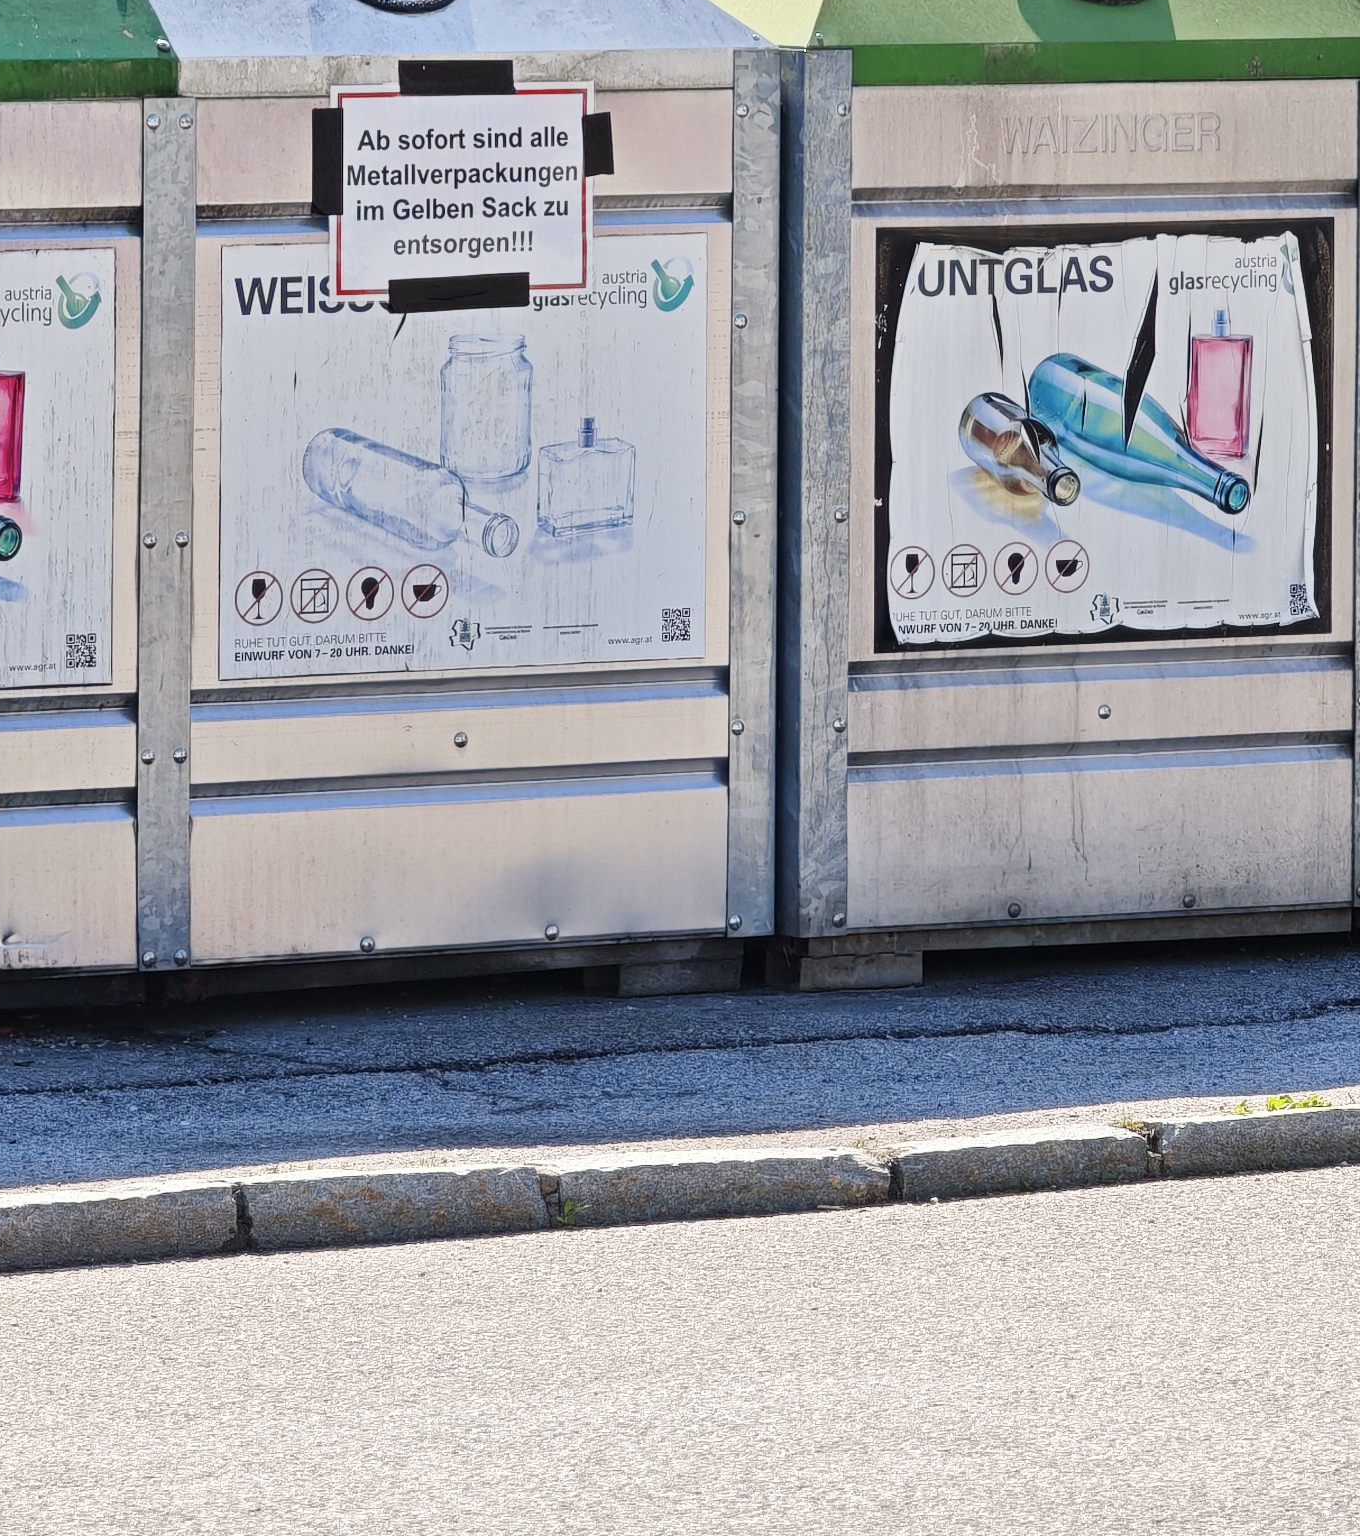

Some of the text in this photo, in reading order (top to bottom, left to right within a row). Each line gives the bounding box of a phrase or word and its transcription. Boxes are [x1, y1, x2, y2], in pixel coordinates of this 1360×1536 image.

[357, 126, 569, 152] Ab sofort sind alle
[1001, 111, 1222, 155] WAIZINGER
[346, 162, 578, 190] Metallverpackungen
[355, 195, 569, 222] im Gelben Sack zu
[393, 230, 534, 259] entsorgen!!!
[1234, 253, 1278, 269] austria
[601, 269, 648, 285] austria
[1169, 269, 1278, 295] glasrecycling
[4, 285, 52, 302] austria
[918, 609, 938, 621] TUT
[940, 609, 963, 621] GUT,
[965, 607, 1003, 620] DARUM
[1005, 606, 1032, 618] BITTE
[939, 622, 962, 634] VON
[992, 620, 1018, 631] UHR.
[1020, 618, 1058, 630] DANKE!
[234, 637, 264, 649] RUHE
[266, 636, 287, 648] TUT
[315, 633, 356, 646] DARUM
[358, 632, 388, 643] BITTE
[234, 649, 285, 662] EINWURF
[288, 648, 312, 660] VON
[345, 646, 372, 658] UHR.
[374, 644, 415, 656] DANKE!
